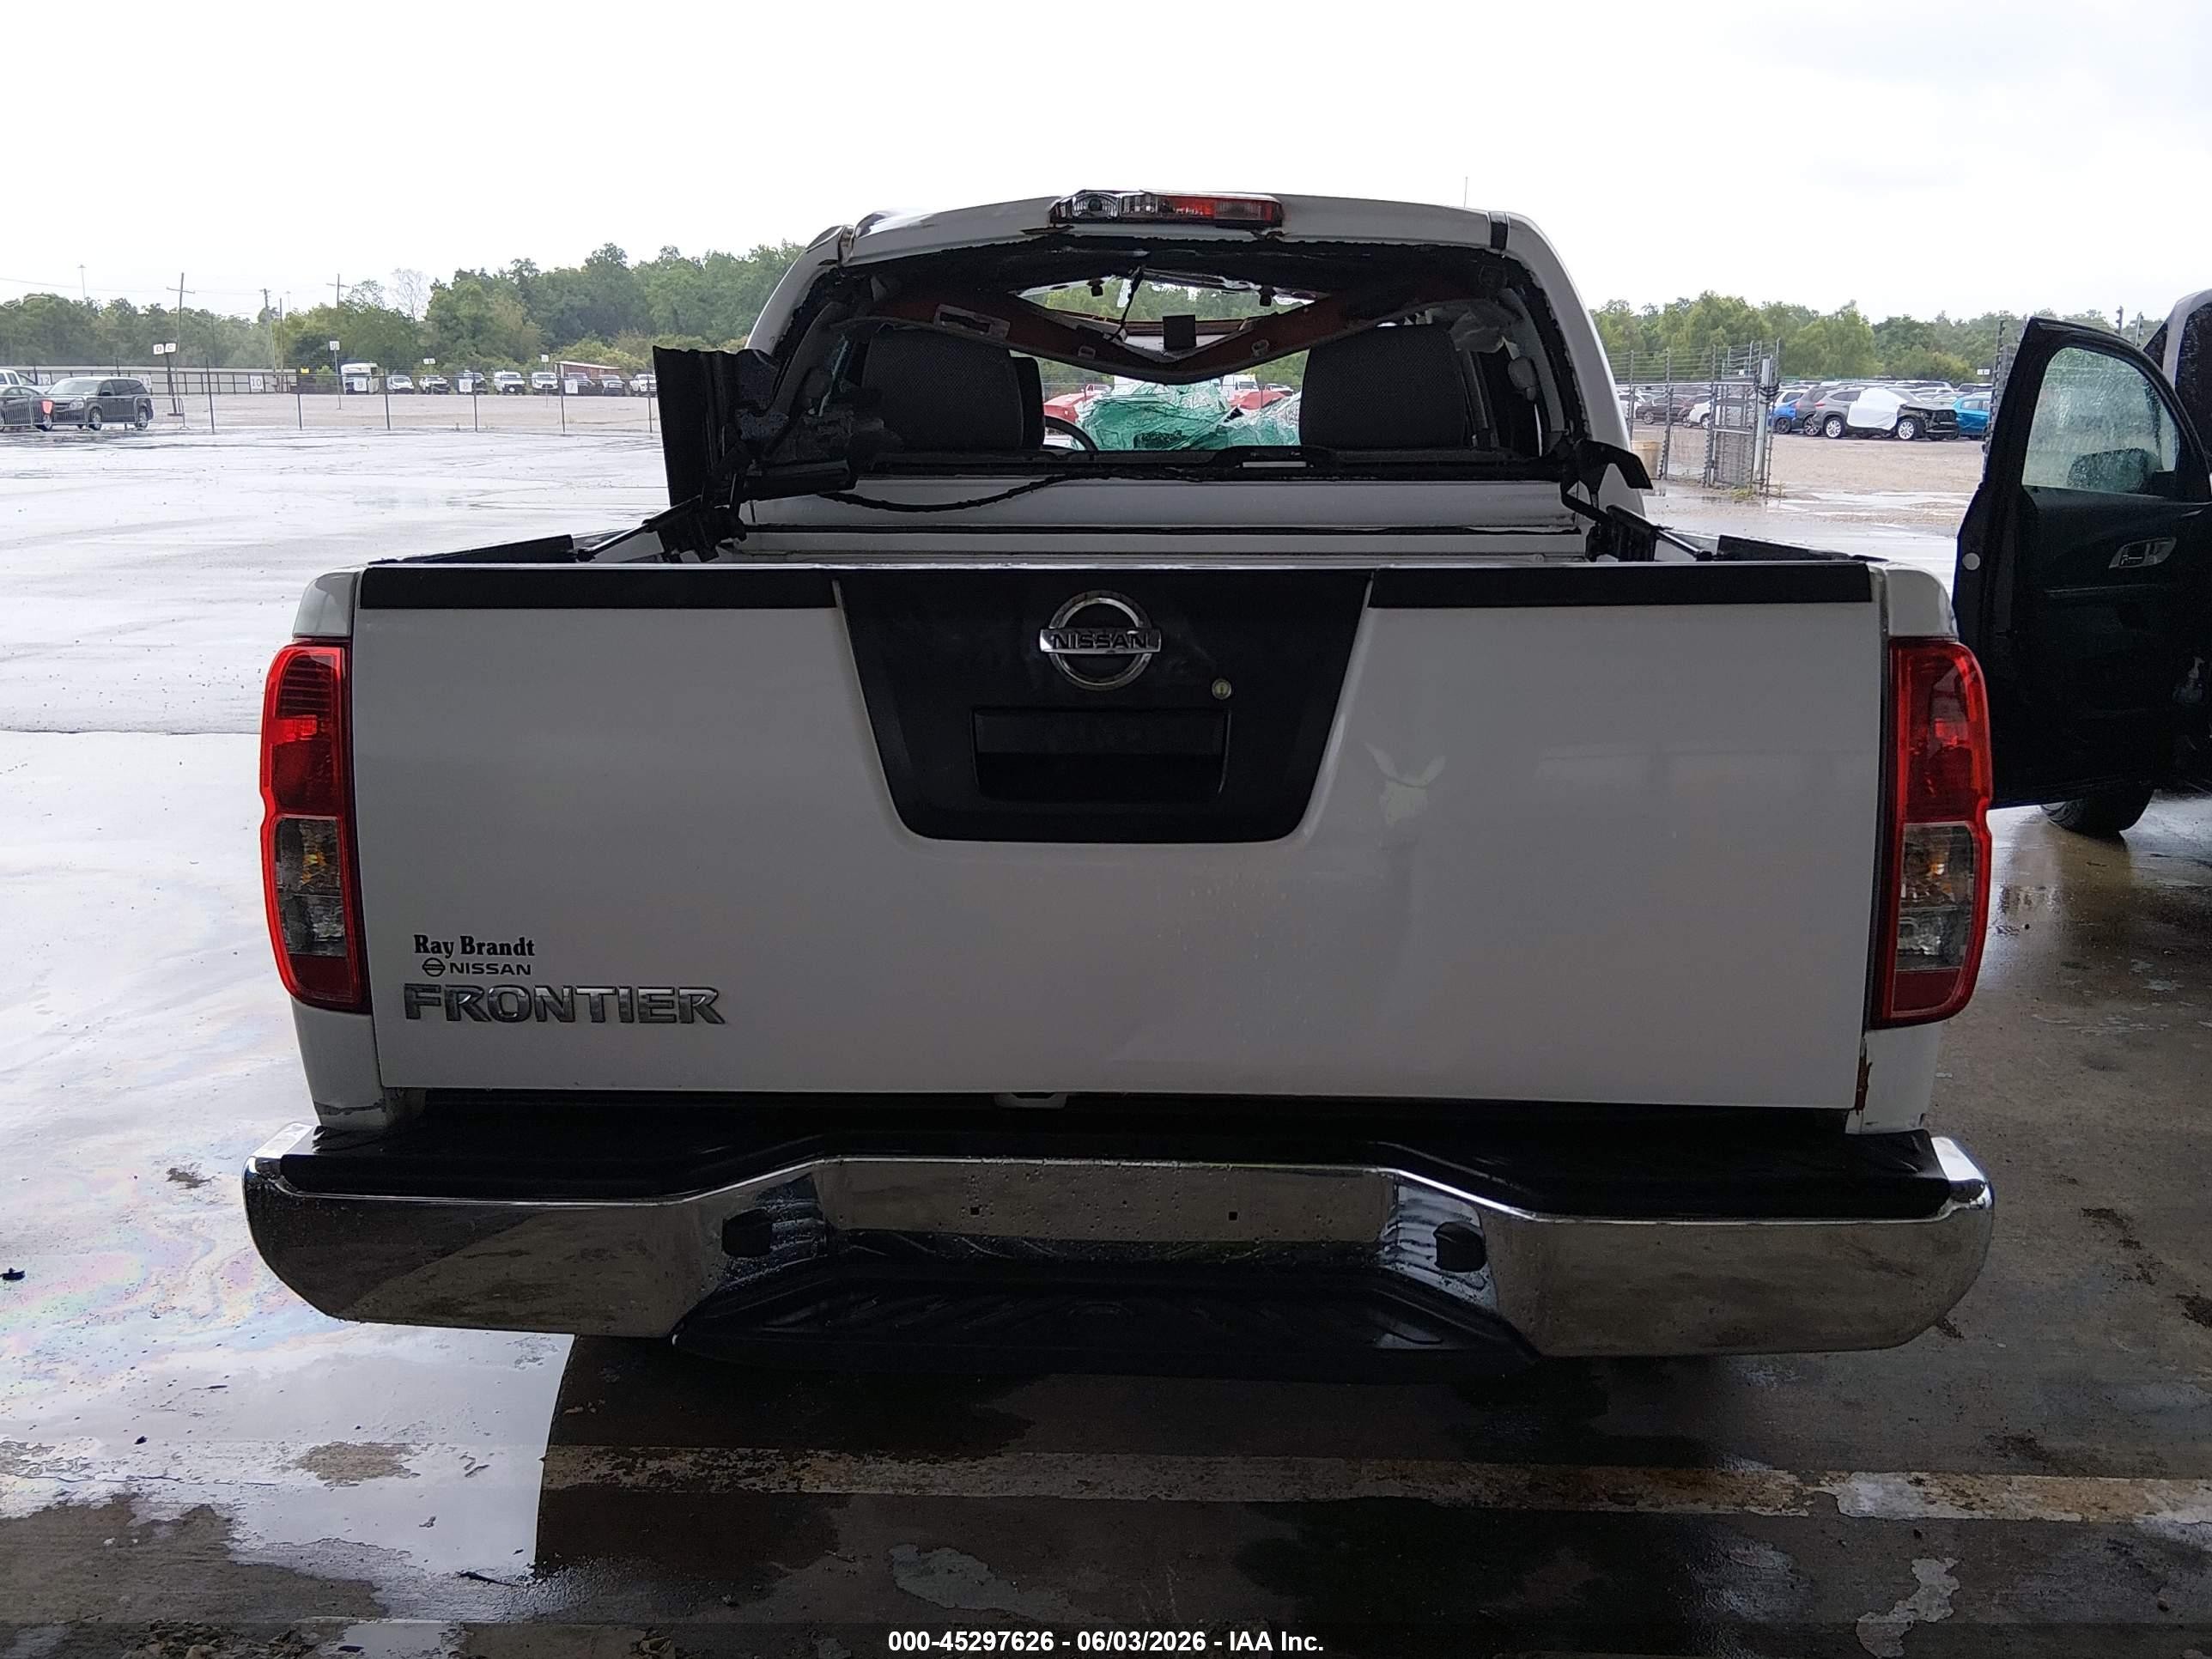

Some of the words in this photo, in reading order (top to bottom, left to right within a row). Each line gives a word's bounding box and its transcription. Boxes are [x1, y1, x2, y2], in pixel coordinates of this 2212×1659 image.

[252, 378, 262, 386] 10
[1053, 633, 1147, 649] NISSAN
[414, 934, 454, 959] Ray
[460, 936, 535, 957] Brandt
[450, 963, 531, 975] NISSAN
[404, 983, 726, 1024] FRONTIER
